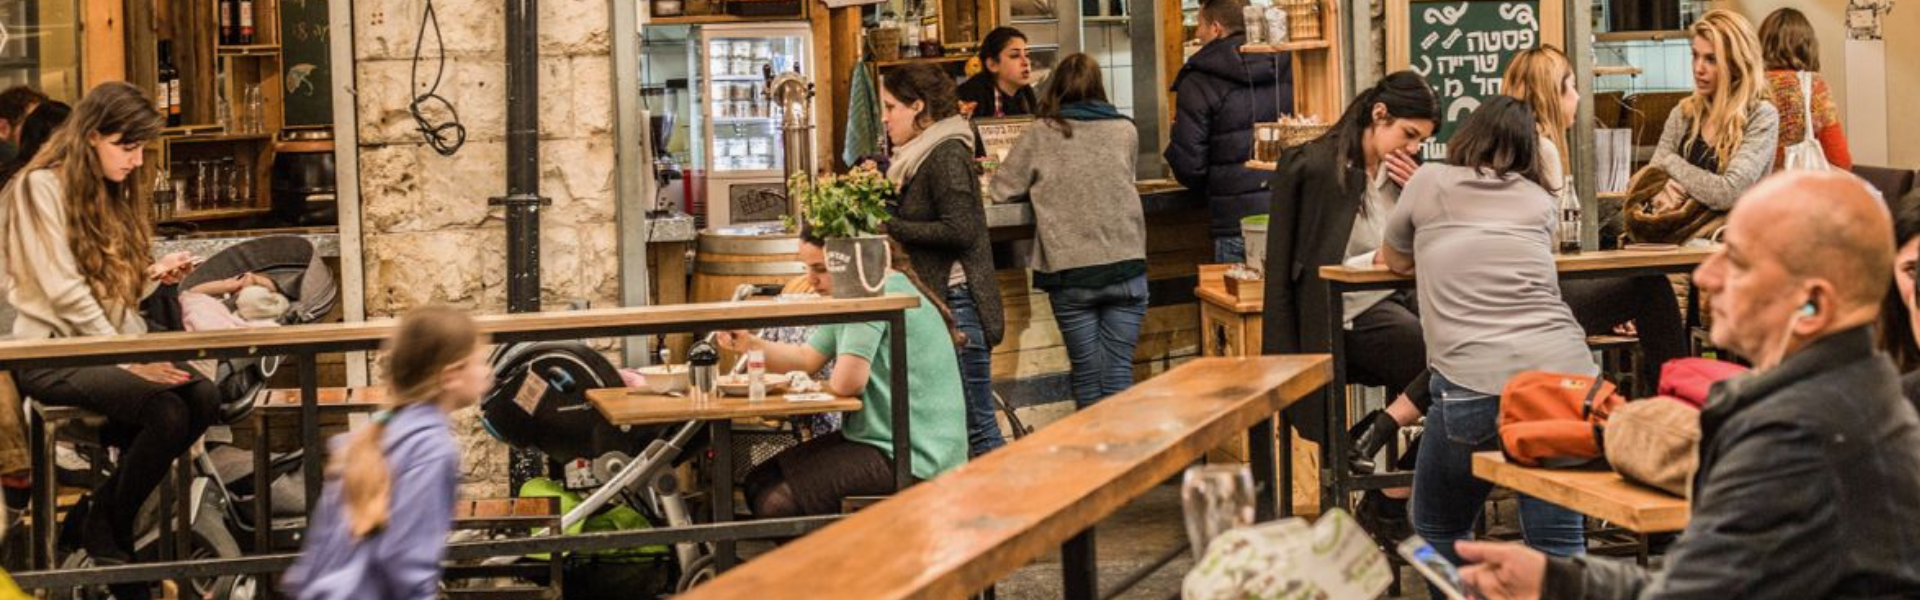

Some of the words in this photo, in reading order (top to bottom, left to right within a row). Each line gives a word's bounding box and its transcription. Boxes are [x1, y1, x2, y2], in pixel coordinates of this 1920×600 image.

[1466, 29, 1534, 52] פסטה
[1436, 53, 1499, 74] טרייה
[1470, 74, 1503, 96] חל
